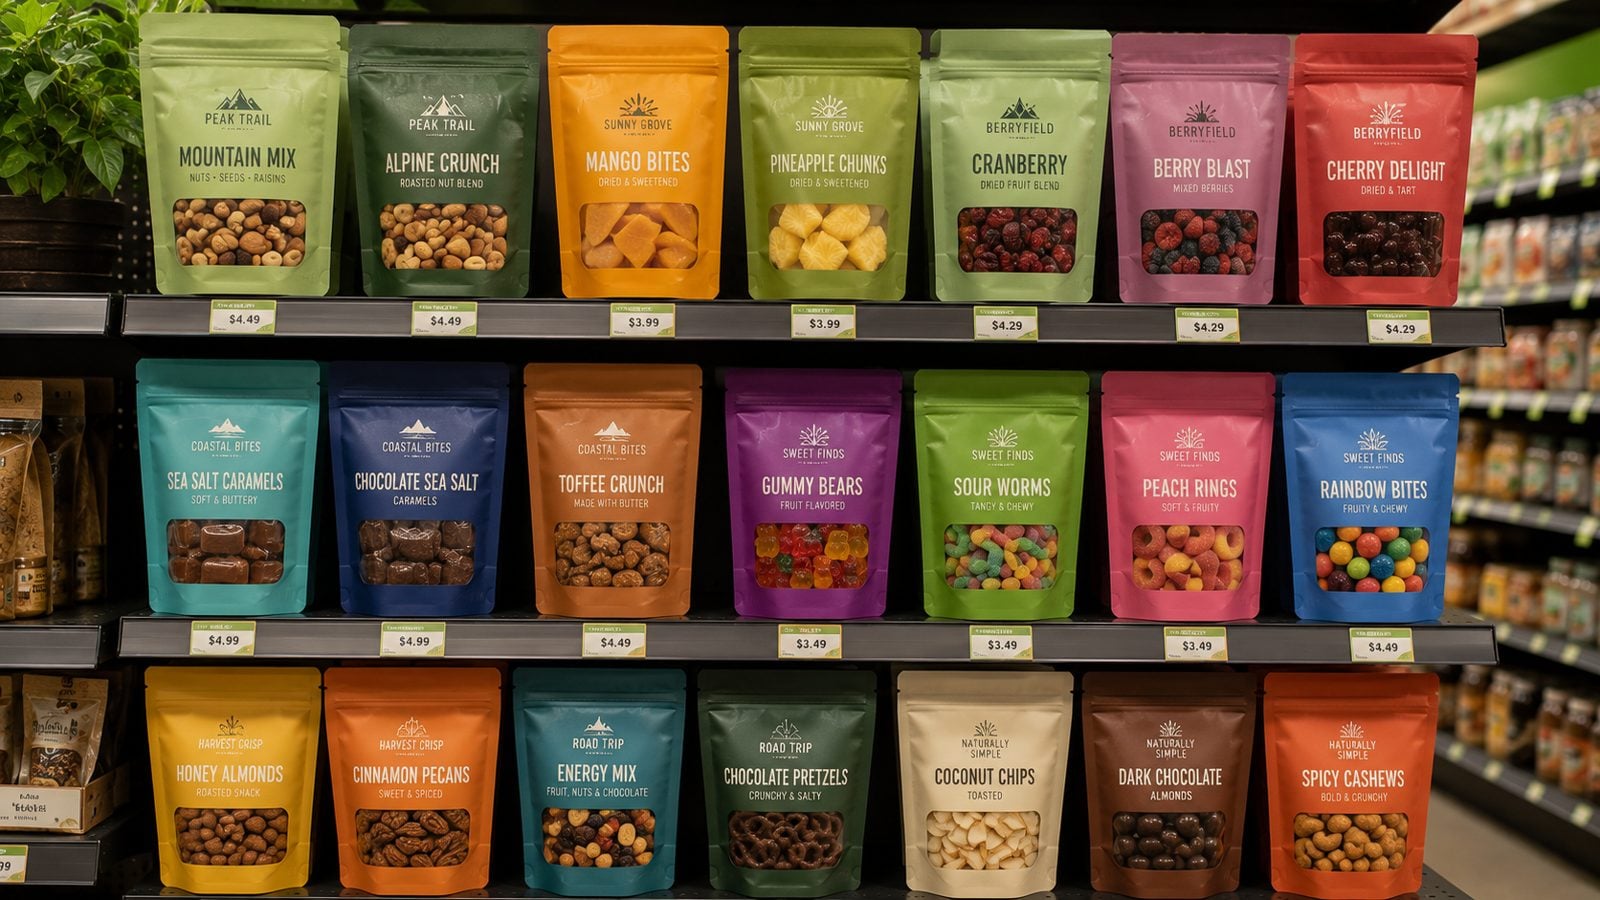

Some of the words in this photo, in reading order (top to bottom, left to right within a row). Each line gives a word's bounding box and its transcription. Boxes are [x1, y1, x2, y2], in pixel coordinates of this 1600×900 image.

[205, 113, 234, 126] PEAK
[240, 113, 272, 126] TRAIL
[604, 119, 637, 130] SUNNY
[410, 119, 438, 131] PEAK
[443, 119, 475, 131] TRAIL
[796, 121, 829, 132] SUNNY
[832, 121, 864, 132] GROVE
[987, 122, 1054, 134] BERRYFIELD
[1169, 127, 1235, 138] BERRYFIELD
[1354, 128, 1421, 140] BERRYFIELD
[179, 146, 262, 169] MOUNTAIN
[267, 146, 296, 169] MIX
[586, 152, 641, 172] MANGO
[647, 152, 689, 172] BITES
[386, 153, 434, 174] ALPINE
[440, 153, 499, 174] CRUNCH
[771, 154, 834, 174] PINEAPPLE
[839, 154, 887, 174] CHUNKS
[972, 153, 1067, 175] CRANBERRY
[1154, 159, 1201, 179] BERRY
[1207, 159, 1251, 179] BLAST
[1327, 160, 1384, 182] CHERRY
[1390, 160, 1445, 182] DELIGHT
[190, 172, 210, 184] NUTS
[219, 172, 244, 184] SEEDS
[254, 172, 286, 184] RAISINS
[599, 177, 621, 187] DRIED
[625, 177, 629, 187] &
[632, 177, 678, 187] SWEETENED
[401, 179, 435, 189] ROASTED
[438, 179, 454, 189] NUT
[457, 179, 483, 189] BLEND
[790, 179, 813, 188] DRIED
[816, 179, 821, 188] &
[824, 179, 869, 188] SWEETENED
[1008, 180, 1031, 190] FRUIT
[1034, 180, 1059, 190] BLEND
[1174, 184, 1198, 193] MIXED
[1202, 184, 1233, 193] BERRIES
[1361, 186, 1386, 195] DRIED
[1388, 186, 1394, 195] &
[1397, 186, 1416, 195] TART
[229, 315, 260, 325] $4.49
[430, 316, 461, 327] $4.49
[629, 318, 659, 328] $3.99
[810, 319, 840, 329] $3.99
[992, 321, 1022, 331] $4.29
[1194, 322, 1224, 332] $4.29
[1386, 324, 1415, 334] $4.29
[192, 441, 231, 452] COASTAL
[235, 441, 261, 452] BITES
[383, 442, 421, 453] COASTAL
[426, 442, 451, 453] BITES
[578, 444, 616, 455] COASTAL
[621, 444, 646, 455] BITES
[783, 448, 813, 459] SWEET
[817, 448, 844, 459] FINDS
[972, 450, 1003, 461] SWEET
[1007, 450, 1033, 461] FINDS
[1160, 451, 1190, 462] SWEET
[1194, 451, 1220, 462] FINDS
[1344, 453, 1374, 463] SWEET
[1378, 453, 1404, 463] FINDS
[167, 472, 187, 491] SEA
[192, 472, 218, 491] SALT
[222, 472, 283, 491] CARAMELS
[355, 473, 419, 491] CHOCOLATE
[424, 473, 446, 491] SEA
[451, 473, 479, 491] SALT
[559, 475, 605, 494] TOFFEE
[610, 475, 664, 494] CRUNCH
[763, 476, 814, 496] GUMMY
[819, 476, 863, 496] BEARS
[954, 477, 991, 497] SOUR
[997, 477, 1050, 497] WORMS
[1143, 479, 1189, 498] PEACH
[1195, 479, 1237, 498] RINGS
[1321, 480, 1387, 499] RAINBOW
[1392, 480, 1427, 499] BITES
[192, 495, 211, 505] SOFT
[214, 495, 219, 505] &
[222, 495, 257, 505] BUTTERY
[393, 496, 437, 505] CARAMELS
[574, 499, 594, 508] MADE
[597, 499, 617, 508] WITH
[620, 499, 648, 508] BUTTER
[781, 501, 802, 510] FRUIT
[806, 501, 845, 510] FLAVORED
[971, 502, 996, 511] TANGY
[999, 502, 1004, 511] &
[1007, 502, 1034, 511] CHEWY
[1162, 503, 1181, 512] SOFT
[1184, 503, 1189, 512] &
[1192, 503, 1219, 512] FRUITY
[1343, 504, 1370, 513] FRUITY
[1373, 504, 1378, 513] &
[1381, 504, 1408, 513] CHEWY
[209, 636, 239, 646] $4.99
[400, 636, 430, 646] $4.99
[601, 638, 631, 648] $4.49
[797, 639, 827, 649] $3.49
[988, 640, 1017, 650] $3.49
[1183, 641, 1212, 651] $3.49
[199, 739, 235, 749] HARVEST
[239, 739, 263, 749] CRISP
[380, 740, 416, 750] HARVEST
[420, 740, 444, 750] CRISP
[573, 738, 598, 750] ROAD
[603, 738, 624, 750] TRIP
[760, 742, 785, 753] ROAD
[790, 742, 812, 753] TRIP
[962, 739, 1009, 748] NATURALLY
[1147, 739, 1195, 748] NATURALLY
[971, 750, 1001, 759] SIMPLE
[1156, 749, 1187, 759] SIMPLE
[1338, 751, 1368, 760] SIMPLE
[177, 765, 216, 783] HONEY
[222, 765, 283, 783] ALMONDS
[353, 766, 417, 784] CINNAMON
[422, 766, 470, 784] PECANS
[558, 764, 607, 783] ENERGY
[613, 764, 636, 783] MIX
[725, 767, 788, 786] CHOCOLATE
[793, 767, 848, 786] PRETZELS
[935, 768, 993, 785] COCONUT
[999, 768, 1035, 785] CHIPS
[1119, 768, 1151, 785] DARK
[1156, 768, 1222, 785] CHOCOLATE
[1302, 770, 1339, 787] SPICY
[1344, 770, 1404, 787] CASHEWS
[197, 788, 231, 797] ROASTED
[379, 789, 403, 798] SWEET
[407, 789, 412, 798] &
[416, 789, 442, 798] SPICED
[546, 787, 569, 797] FRUIT,
[572, 787, 591, 797] NUTS
[594, 787, 600, 797] &
[603, 787, 648, 797] CHOCOLATE
[749, 791, 786, 800] CRUNCHY
[789, 791, 794, 800] &
[798, 791, 821, 800] SALTY
[968, 791, 1002, 800] TOASTED
[1151, 791, 1192, 800] ALMONDS
[1321, 793, 1342, 802] BOLD
[1344, 793, 1349, 802] &
[1352, 793, 1388, 802] CRUNCHY
